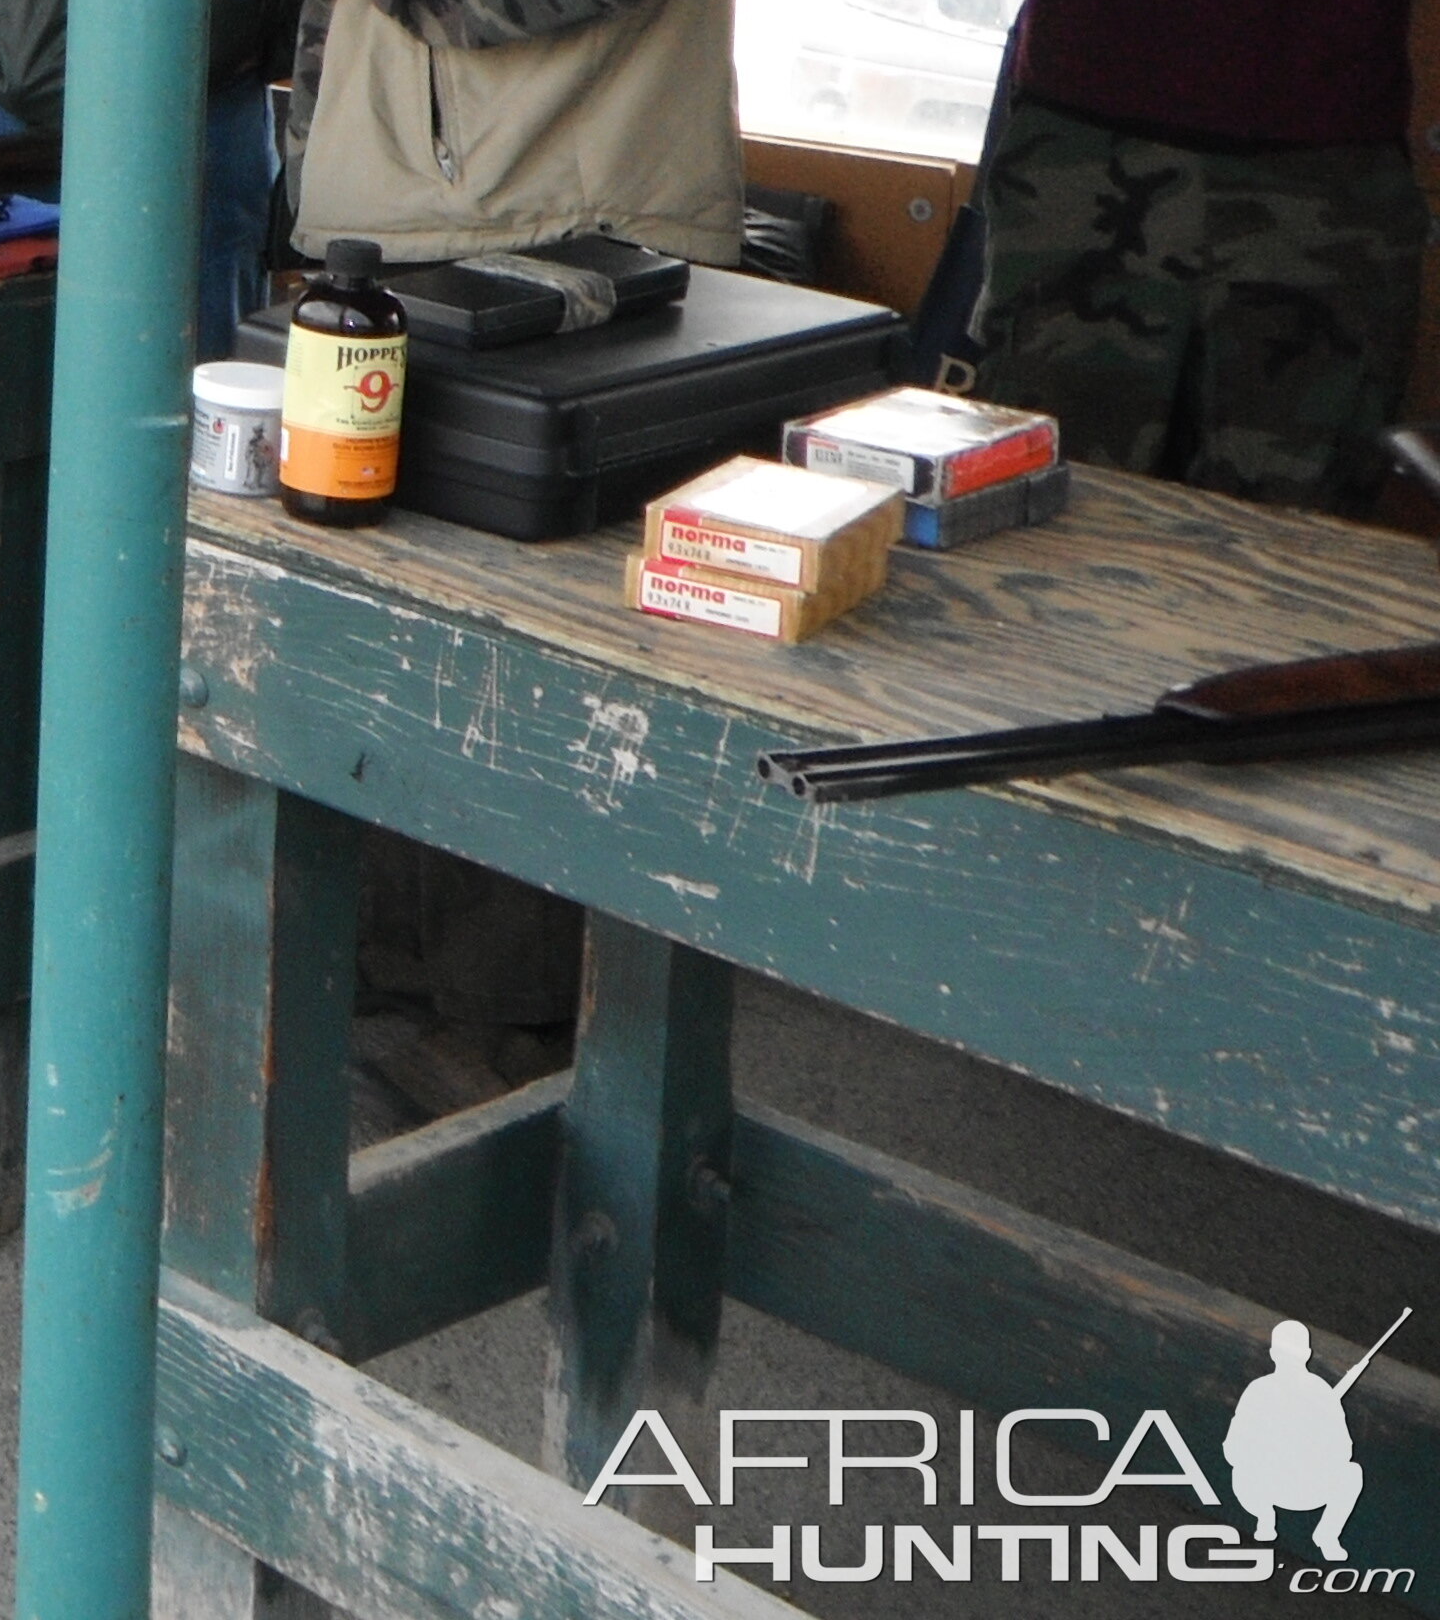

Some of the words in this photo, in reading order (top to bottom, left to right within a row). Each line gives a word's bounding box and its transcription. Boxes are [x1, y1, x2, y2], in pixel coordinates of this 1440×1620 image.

[353, 369, 395, 414] 9
[670, 525, 747, 554] norma
[650, 576, 726, 605] norma
